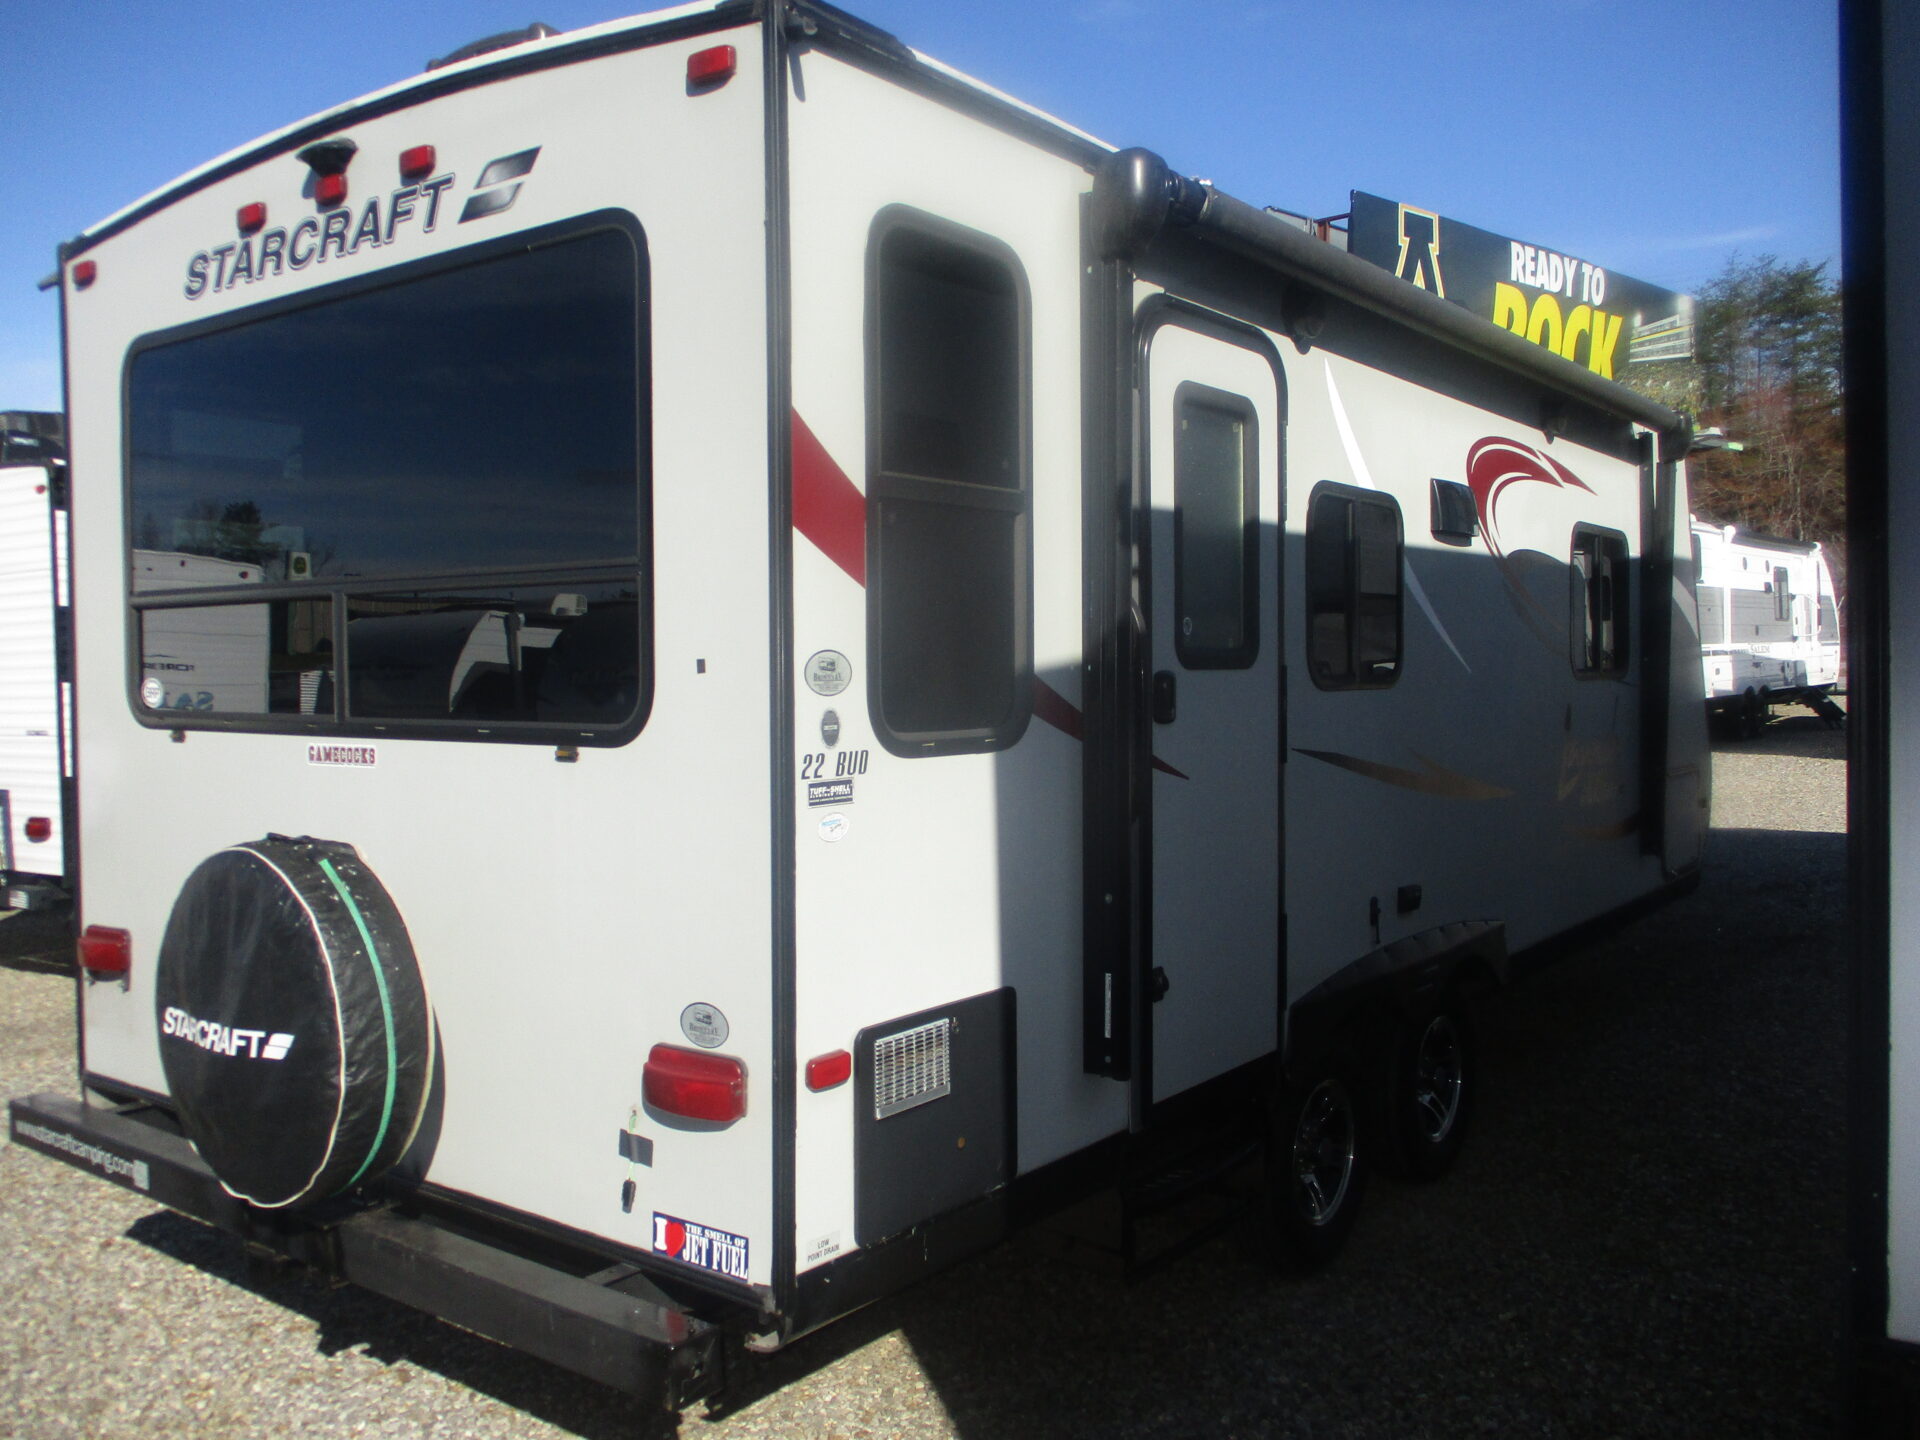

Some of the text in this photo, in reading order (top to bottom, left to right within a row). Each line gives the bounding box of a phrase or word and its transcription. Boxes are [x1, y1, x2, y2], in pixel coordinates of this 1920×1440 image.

[183, 172, 456, 300] STARCRAFT
[1510, 240, 1606, 306] READY TO
[308, 745, 376, 764] GAMECOCKS
[801, 753, 825, 780] 22
[162, 1006, 266, 1058] STARCRAFT
[654, 1217, 668, 1251] I
[685, 1223, 747, 1249] THE SMELL OF
[817, 1238, 830, 1249] LOW
[682, 1233, 748, 1280] JET FUEL
[807, 1250, 823, 1263] POINT
